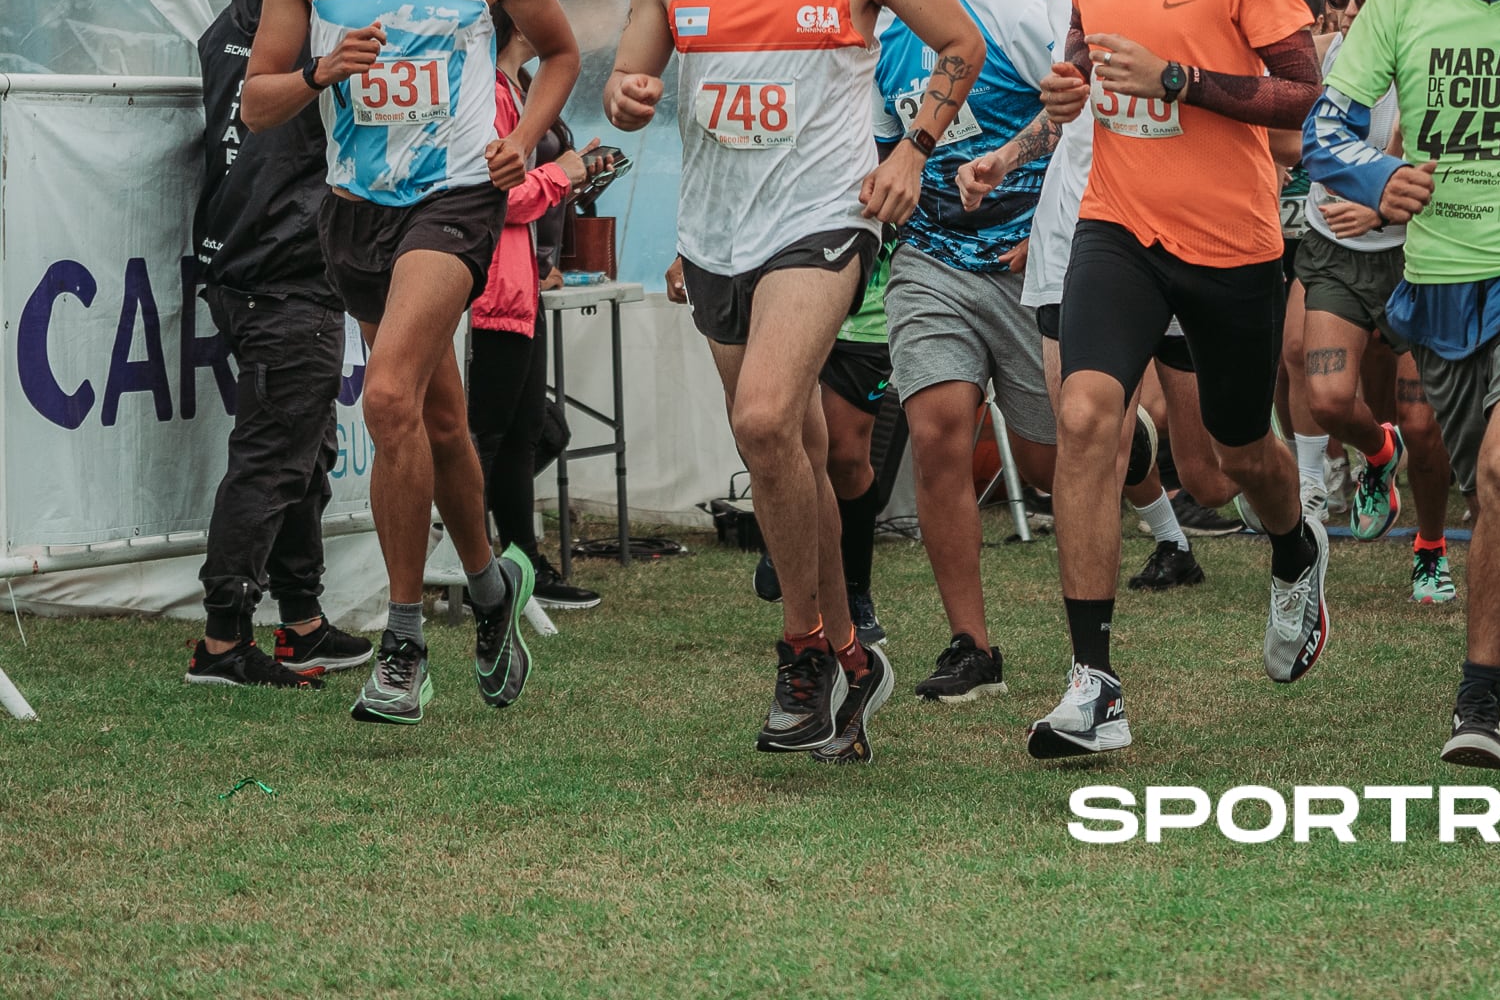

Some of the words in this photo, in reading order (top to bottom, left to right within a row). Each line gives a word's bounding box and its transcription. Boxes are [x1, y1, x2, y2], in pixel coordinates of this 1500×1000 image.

[360, 60, 441, 109] 531
[1428, 77, 1446, 93] DE
[701, 83, 789, 133] 748
[1426, 92, 1444, 108] LA
[1453, 176, 1464, 184] de
[1435, 201, 1495, 214] MUNICIPALIDAD
[1301, 629, 1322, 665] FILA
